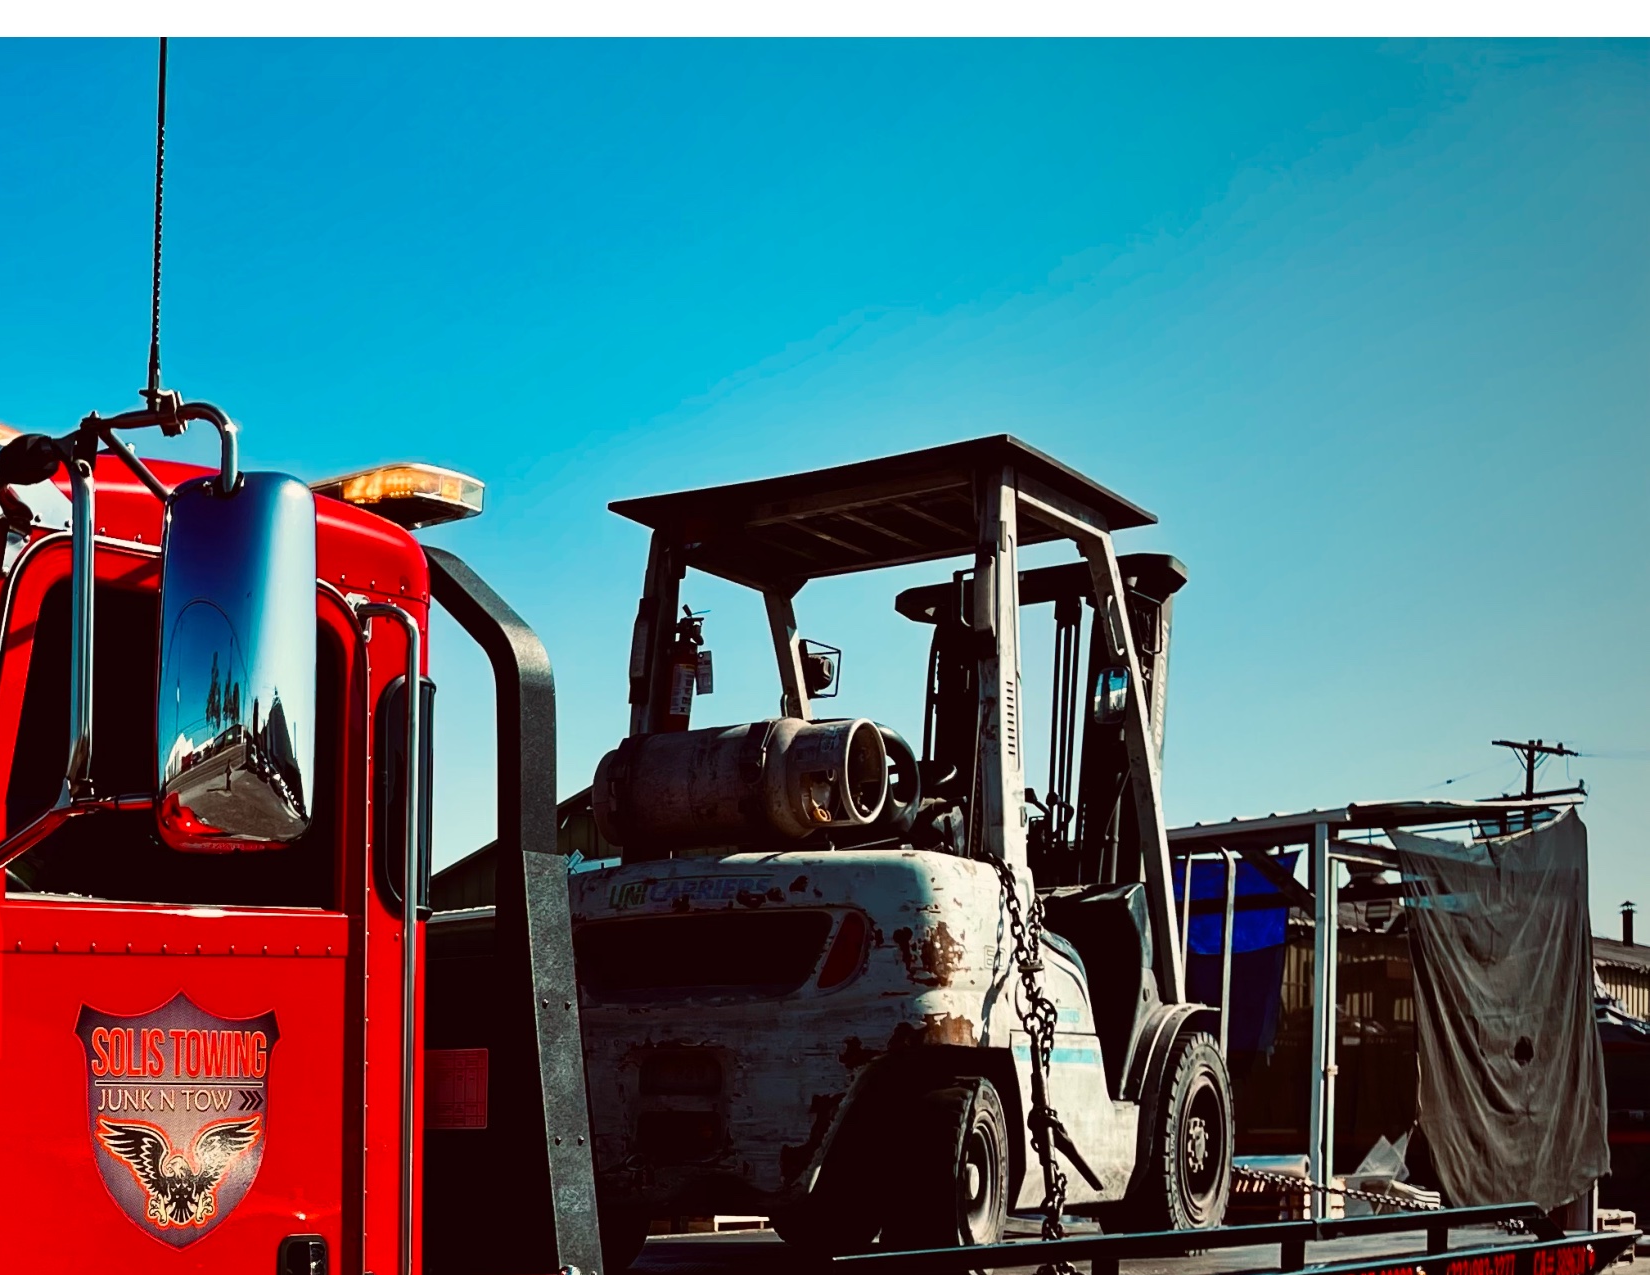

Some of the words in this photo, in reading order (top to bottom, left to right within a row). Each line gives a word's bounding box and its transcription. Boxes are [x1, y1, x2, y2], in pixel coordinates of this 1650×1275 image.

[91, 1026, 165, 1077] SOLIS
[169, 1029, 267, 1078] TOWING
[97, 1089, 152, 1112] JUNK
[160, 1090, 175, 1111] N
[182, 1090, 233, 1112] TOW
